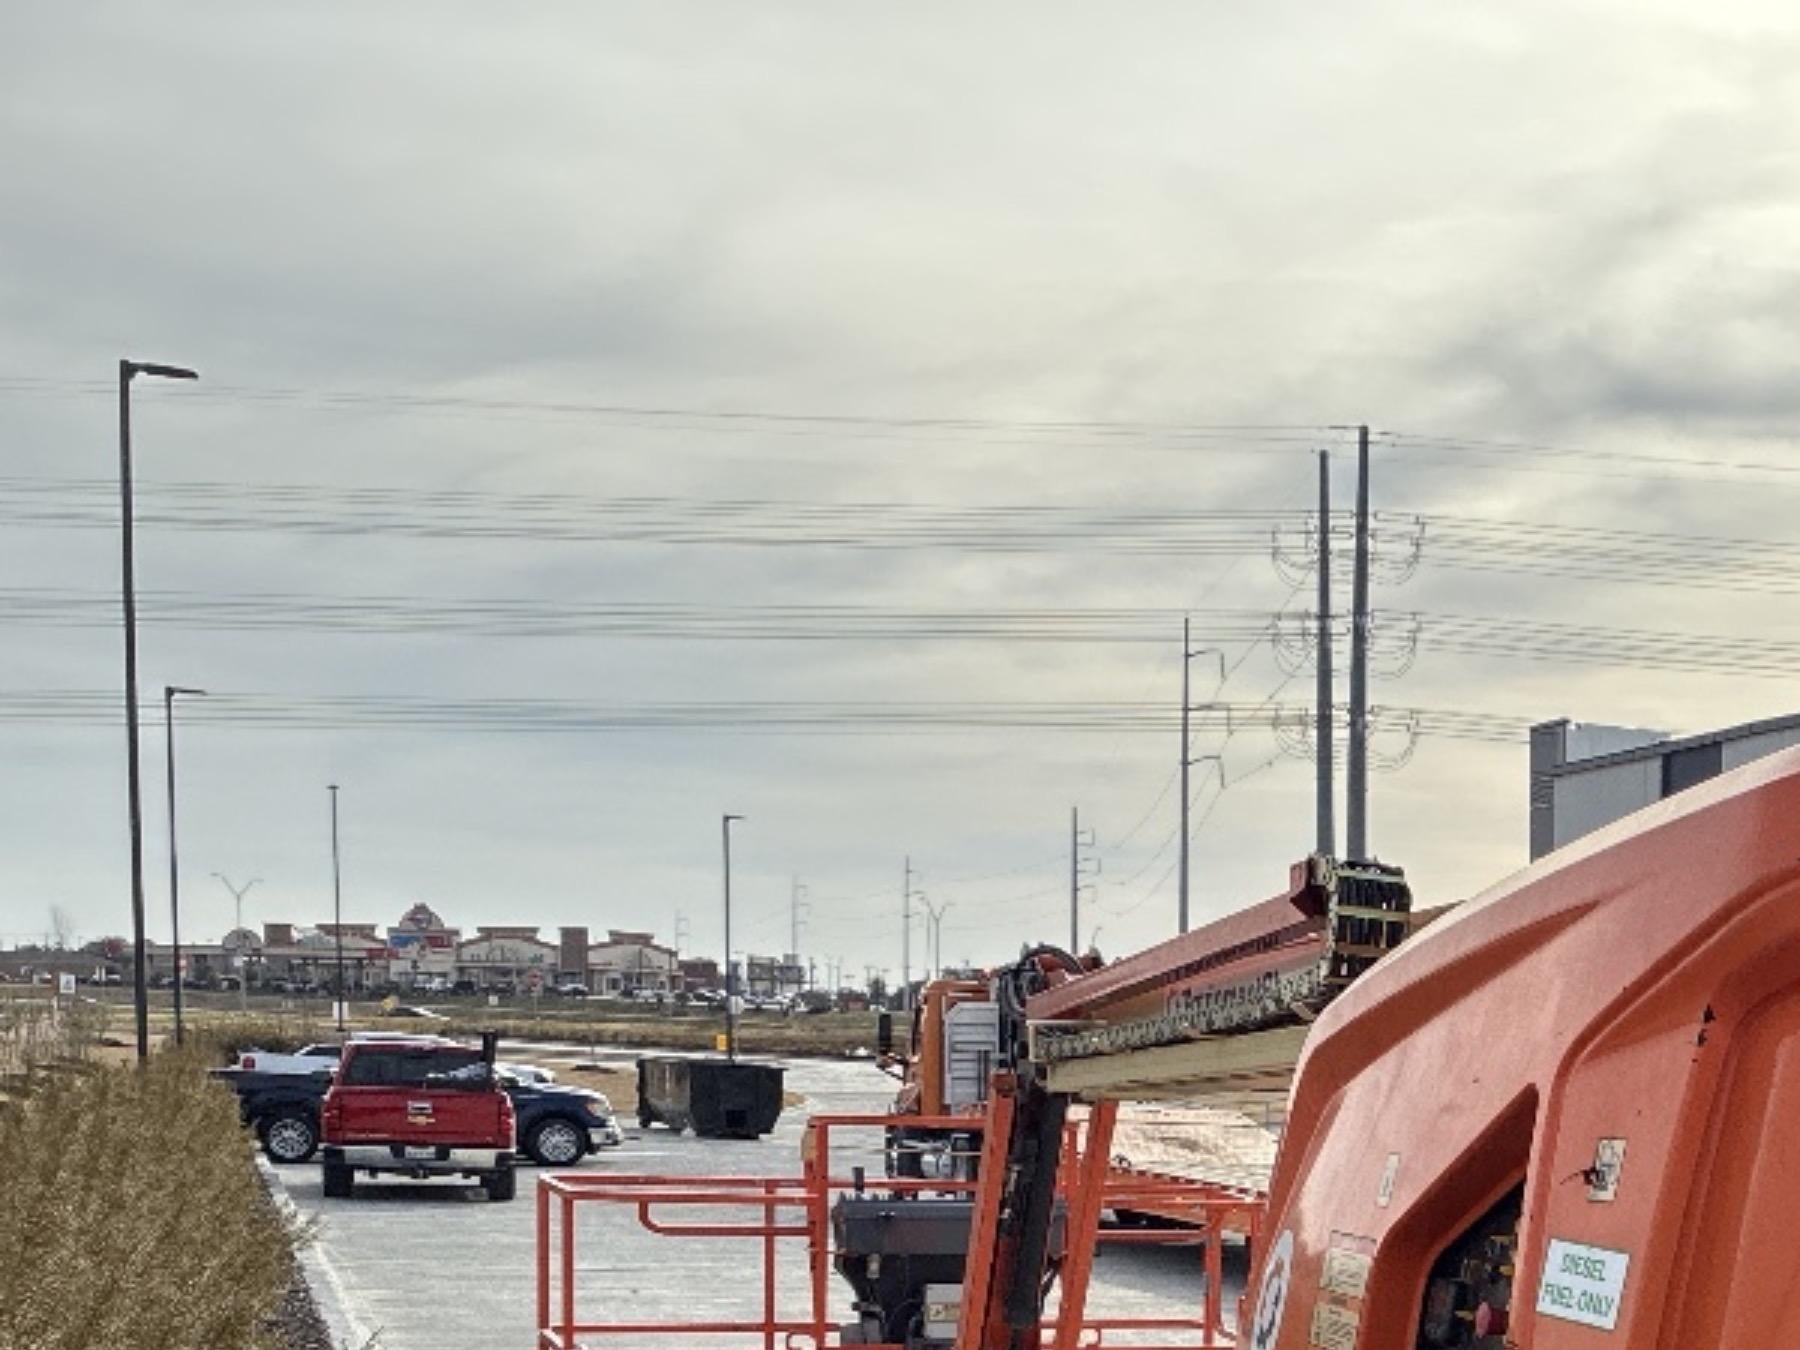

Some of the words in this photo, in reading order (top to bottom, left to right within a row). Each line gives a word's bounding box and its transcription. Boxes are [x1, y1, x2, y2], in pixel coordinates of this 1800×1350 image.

[1560, 1253, 1606, 1281] DIESEL
[1543, 1283, 1574, 1309] FUEL
[1577, 1289, 1614, 1317] ONLY
